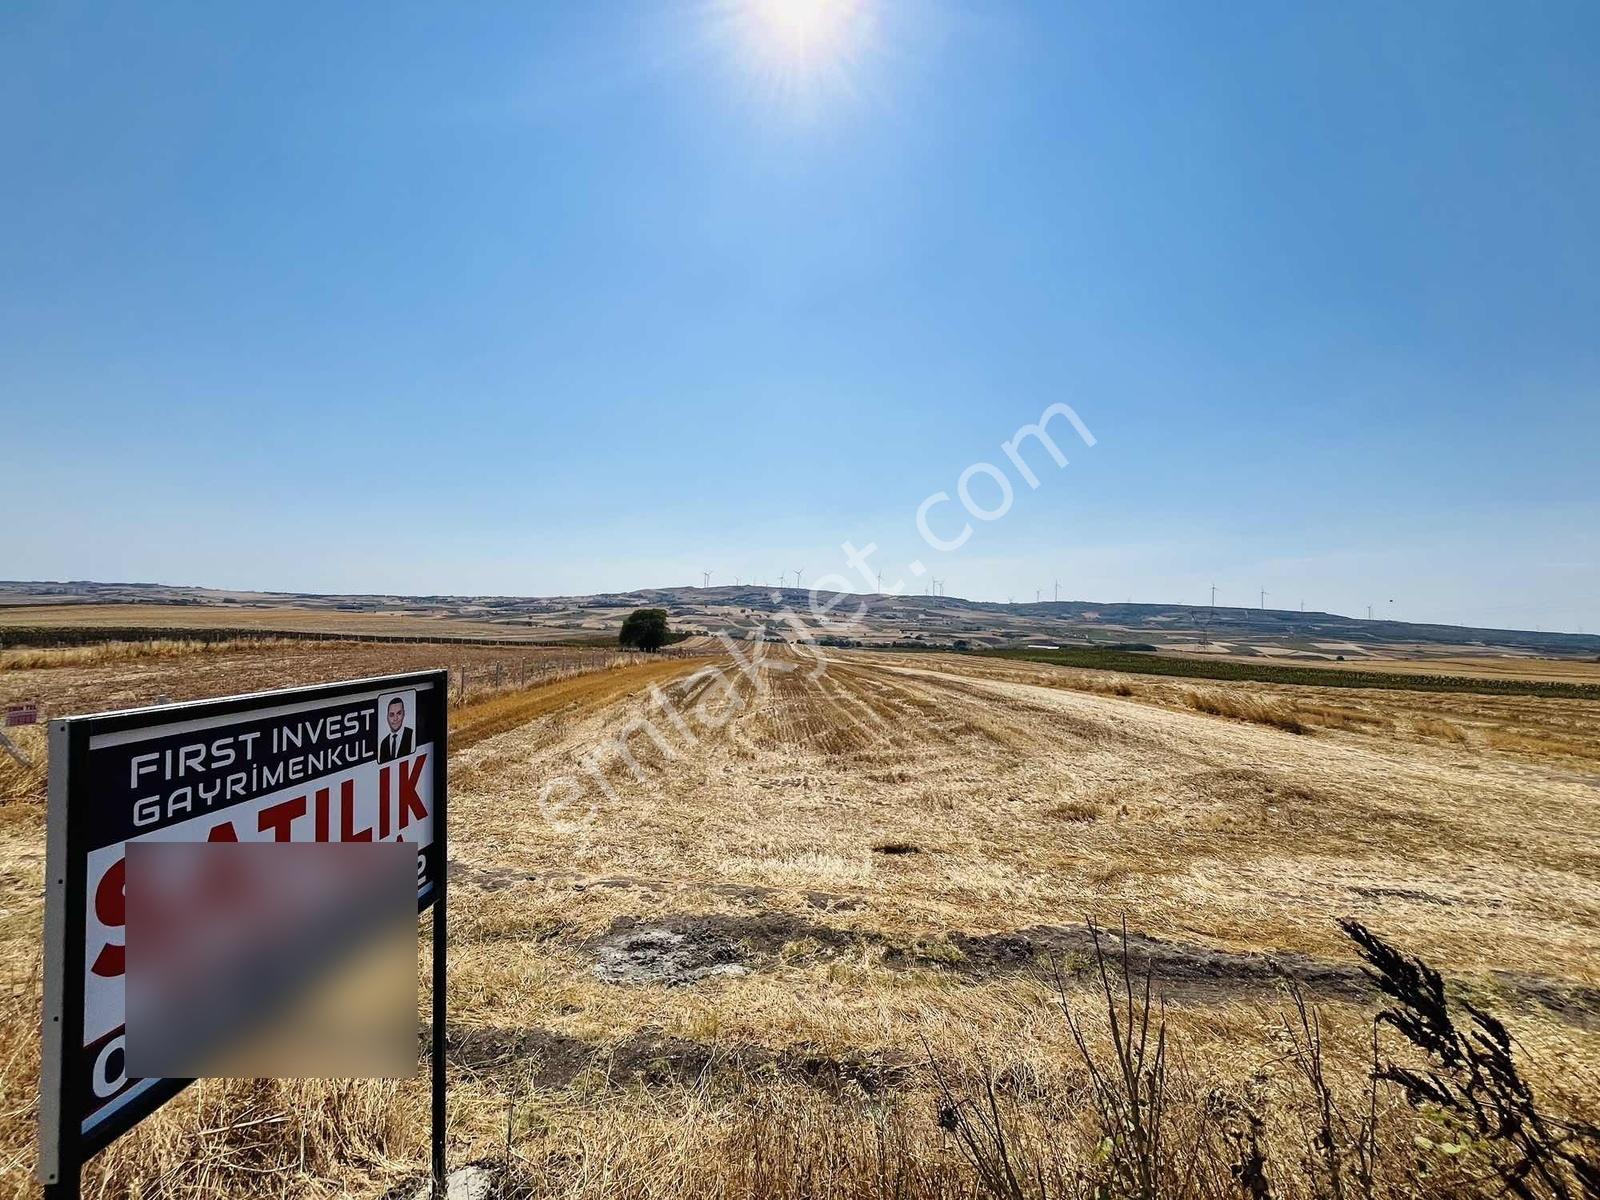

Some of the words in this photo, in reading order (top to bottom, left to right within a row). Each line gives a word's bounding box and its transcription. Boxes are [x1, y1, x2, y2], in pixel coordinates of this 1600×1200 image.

[131, 732, 261, 788] FIRST
[273, 709, 375, 754] INVEST
[133, 739, 375, 827] GAYRİMENKUL
